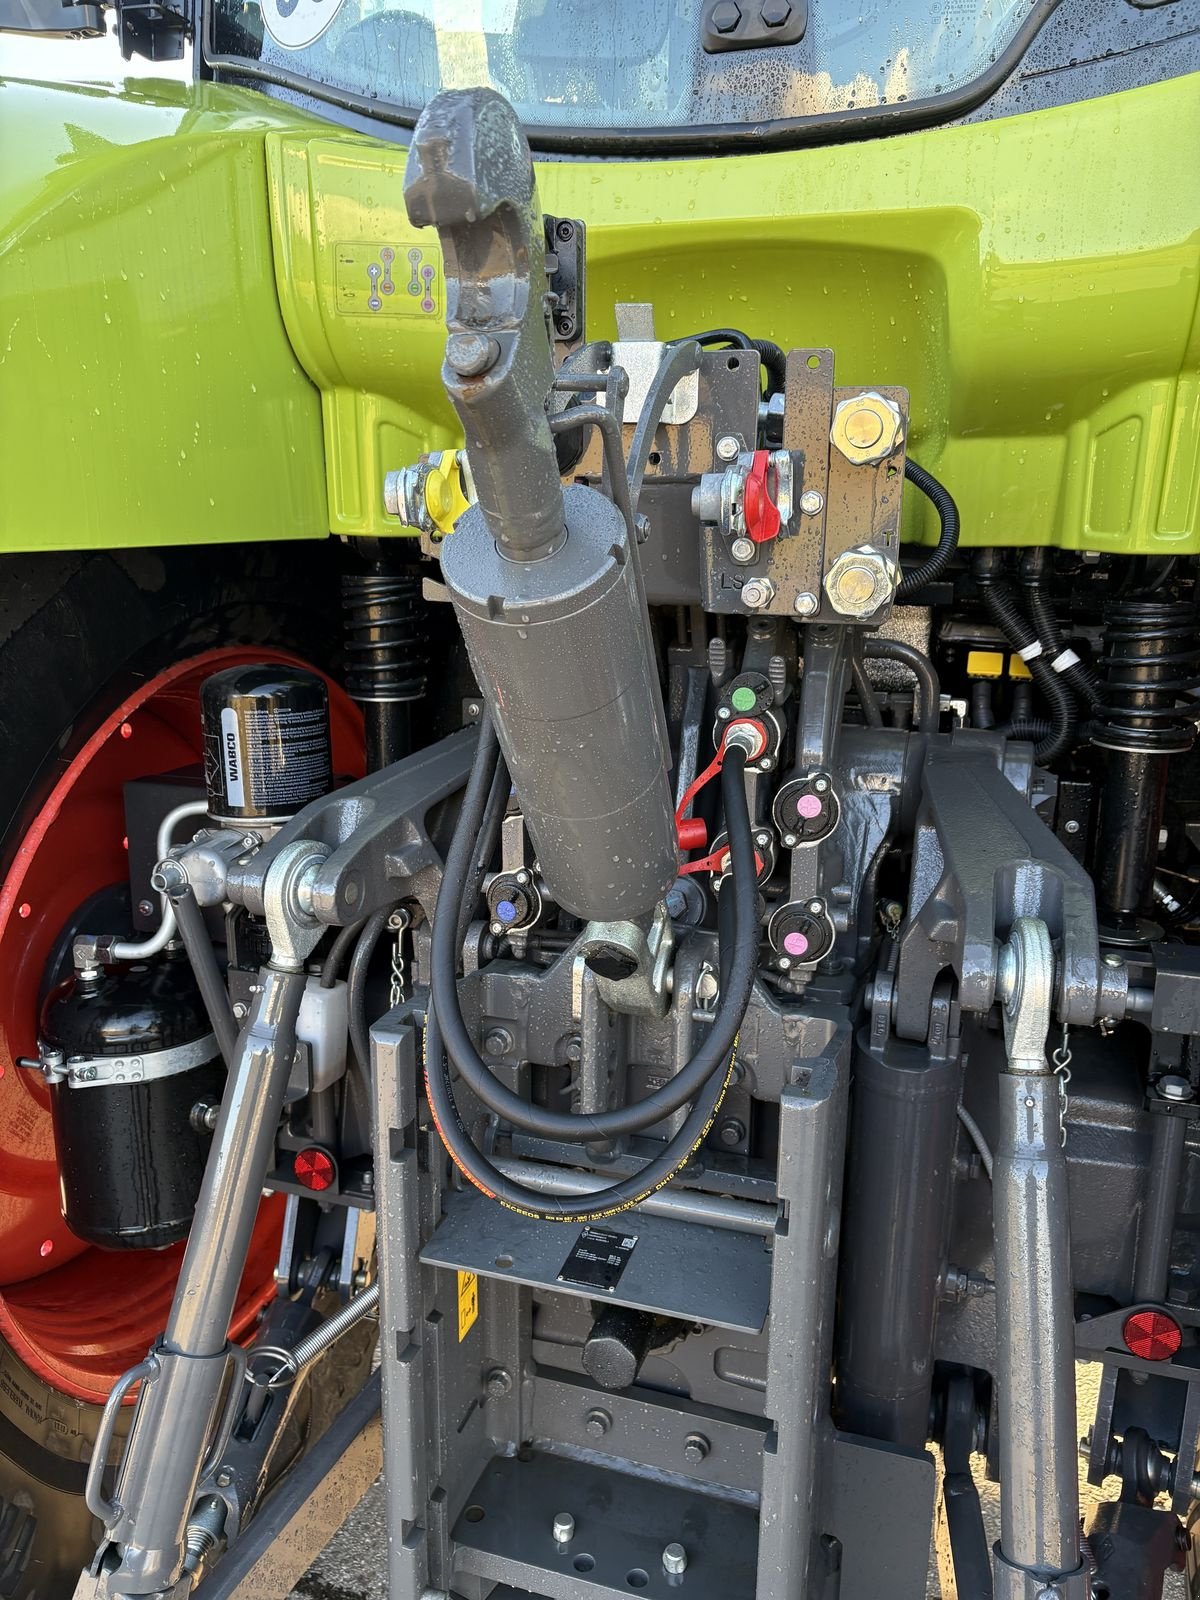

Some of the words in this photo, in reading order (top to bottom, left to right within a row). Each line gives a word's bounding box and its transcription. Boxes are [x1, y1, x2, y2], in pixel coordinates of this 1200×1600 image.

[882, 529, 894, 548] T
[721, 573, 744, 590] LS
[227, 733, 238, 782] WABCO
[714, 1089, 726, 1112] Flame
[655, 1173, 675, 1191] DN10
[692, 1137, 703, 1151] WP
